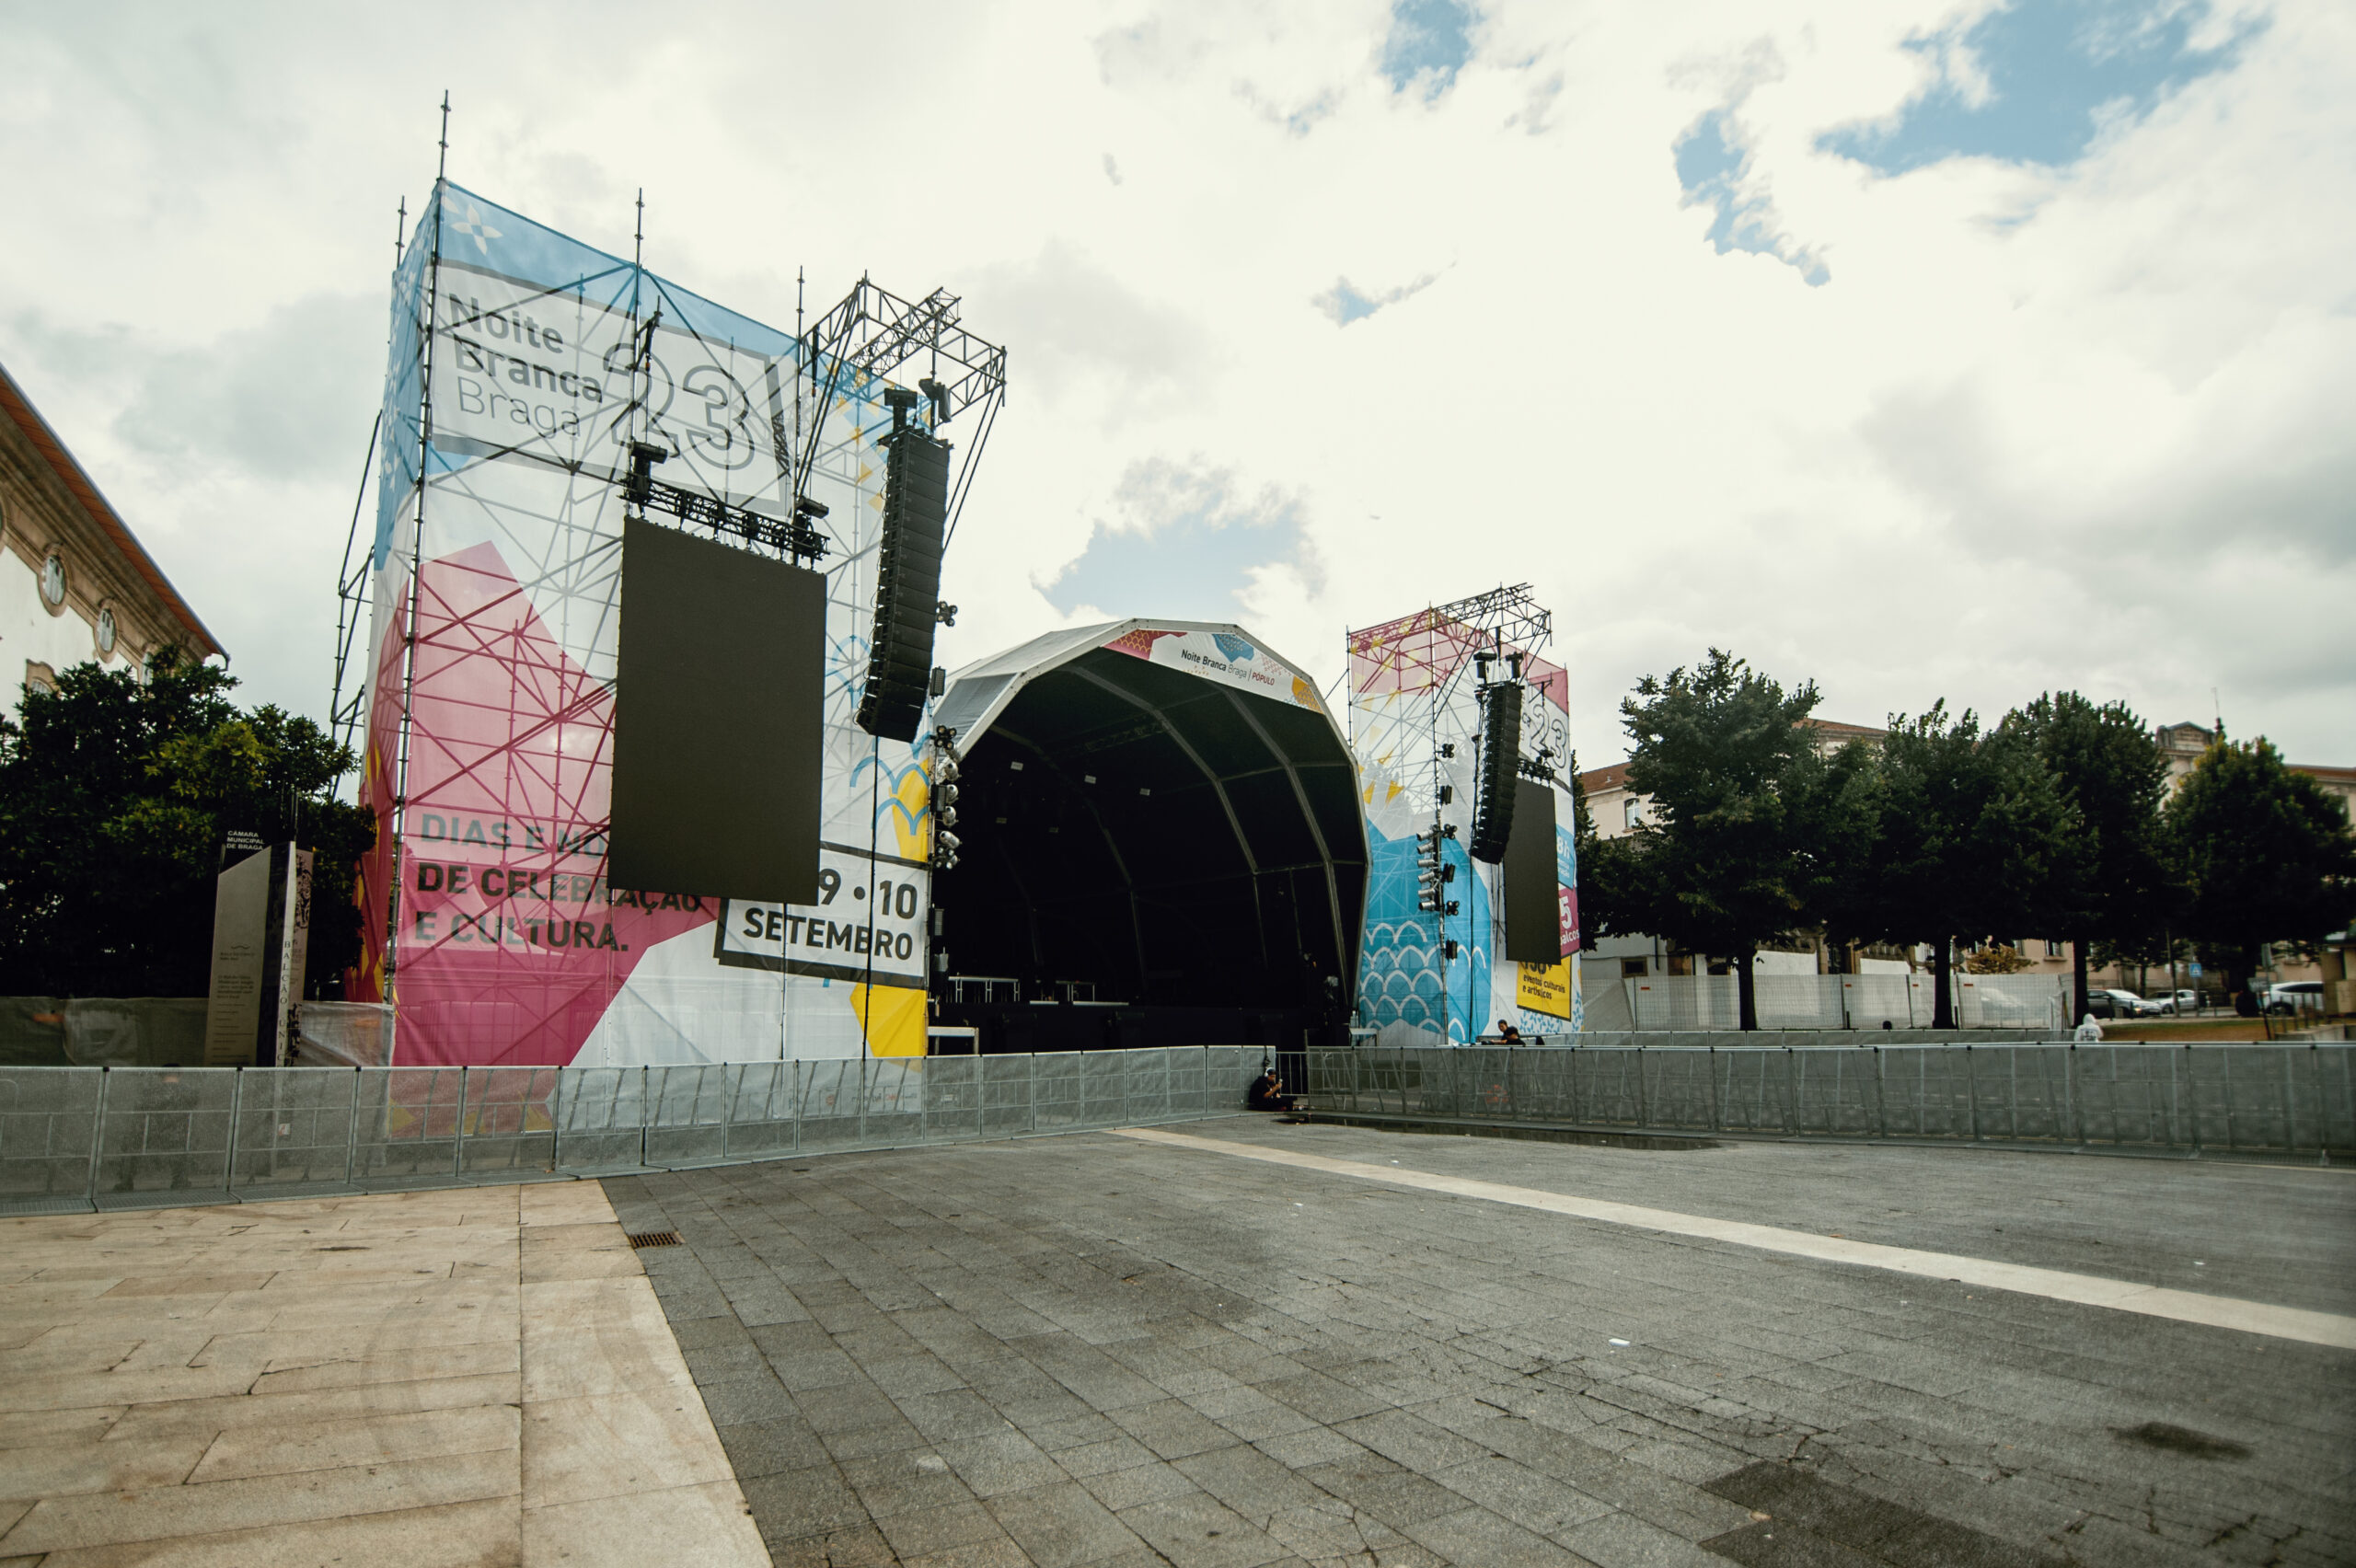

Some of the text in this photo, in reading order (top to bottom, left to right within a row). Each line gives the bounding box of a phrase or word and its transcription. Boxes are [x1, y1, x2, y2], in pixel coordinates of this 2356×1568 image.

[448, 293, 564, 354] Noite
[453, 333, 604, 403] Branca
[456, 375, 582, 439] Braga
[603, 342, 756, 471] 23
[1181, 649, 1201, 663] Noite
[1202, 655, 1227, 672] Branca
[1227, 663, 1247, 679] Braga
[1530, 704, 1567, 768] 23
[226, 836, 265, 845] MUNICIPAL
[421, 813, 512, 851] DIAS
[525, 825, 544, 855] E
[417, 862, 468, 894] DE
[819, 868, 841, 905] 9
[880, 880, 918, 919] 10
[414, 911, 629, 951] E CULTURA.
[743, 907, 913, 961] SETEMBRO
[1559, 896, 1573, 929] 5
[1523, 974, 1565, 994] eventos culturais
